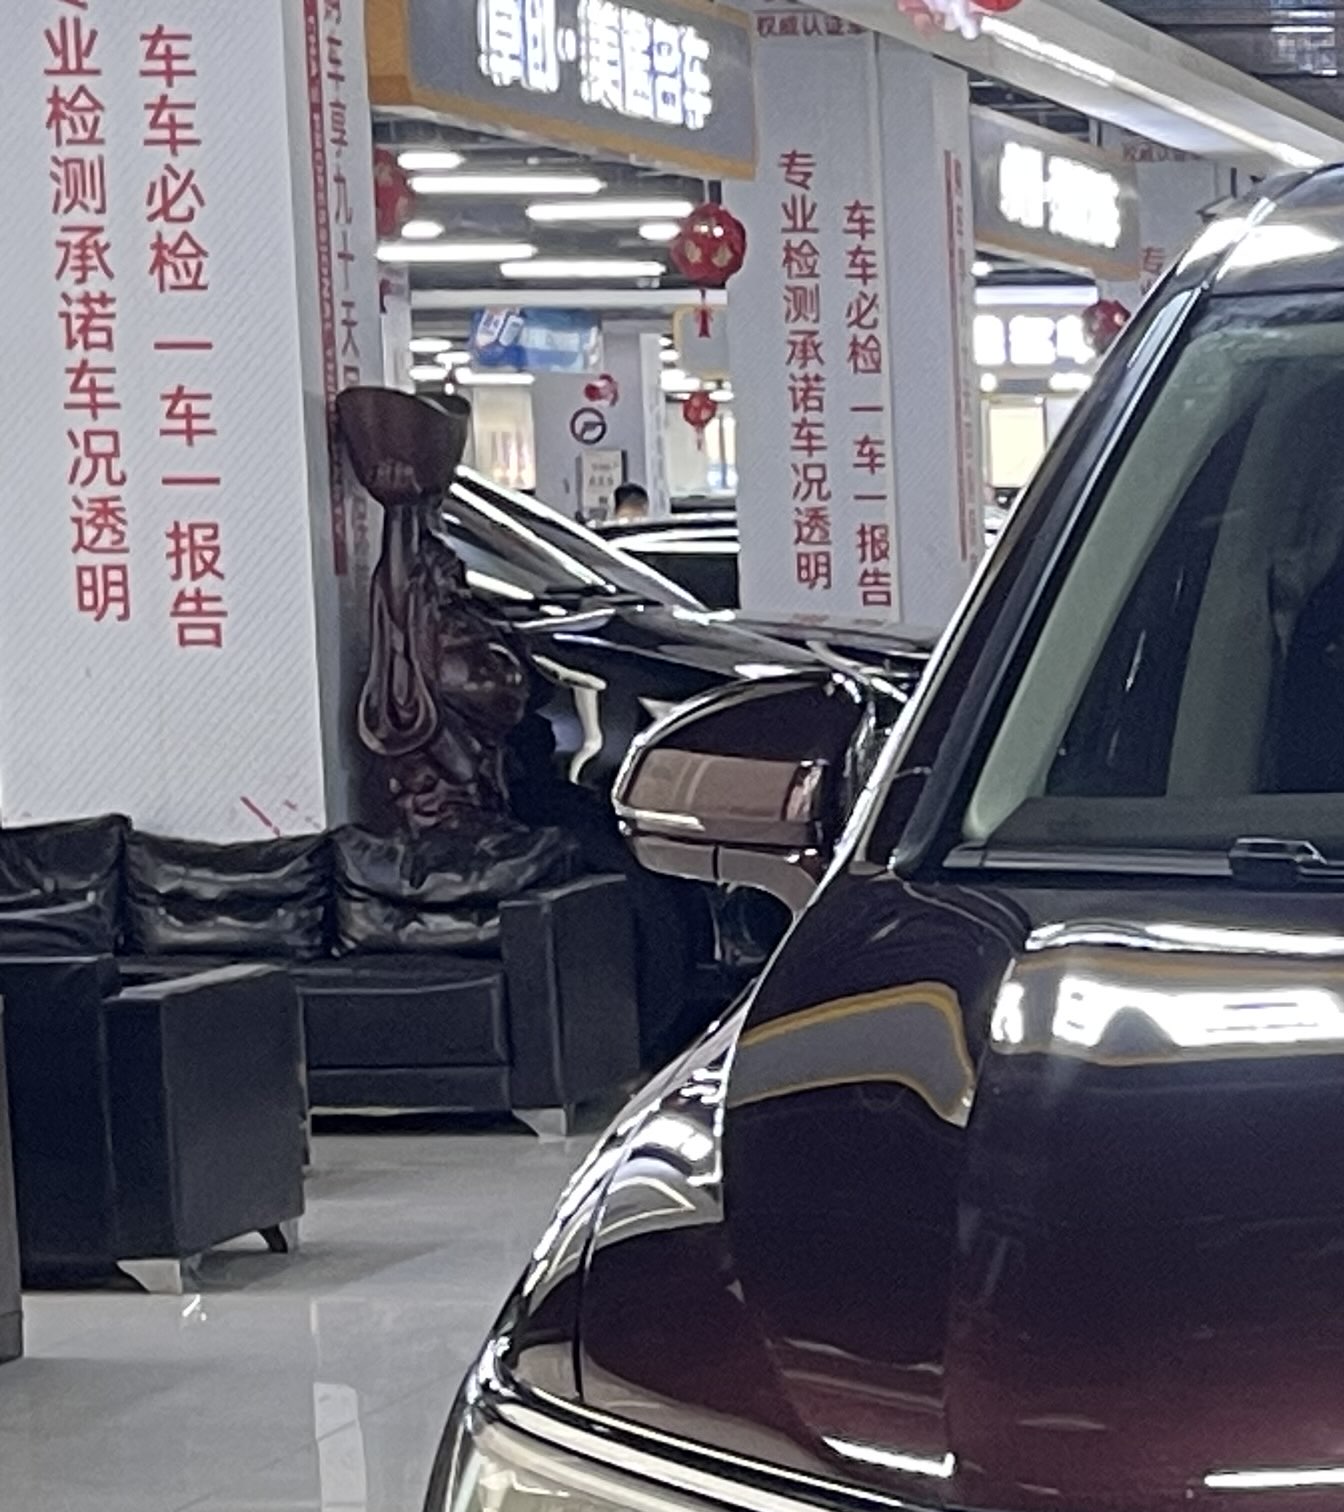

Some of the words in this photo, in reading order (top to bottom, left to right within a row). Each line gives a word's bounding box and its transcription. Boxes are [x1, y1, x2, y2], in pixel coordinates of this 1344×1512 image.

[43, 0, 132, 622] 业检测承诺车况透明
[139, 23, 228, 648] 车车必检一车一报告
[778, 149, 833, 590] 专业检测承诺车况透明
[842, 200, 892, 607] 车车必检一车一报告
